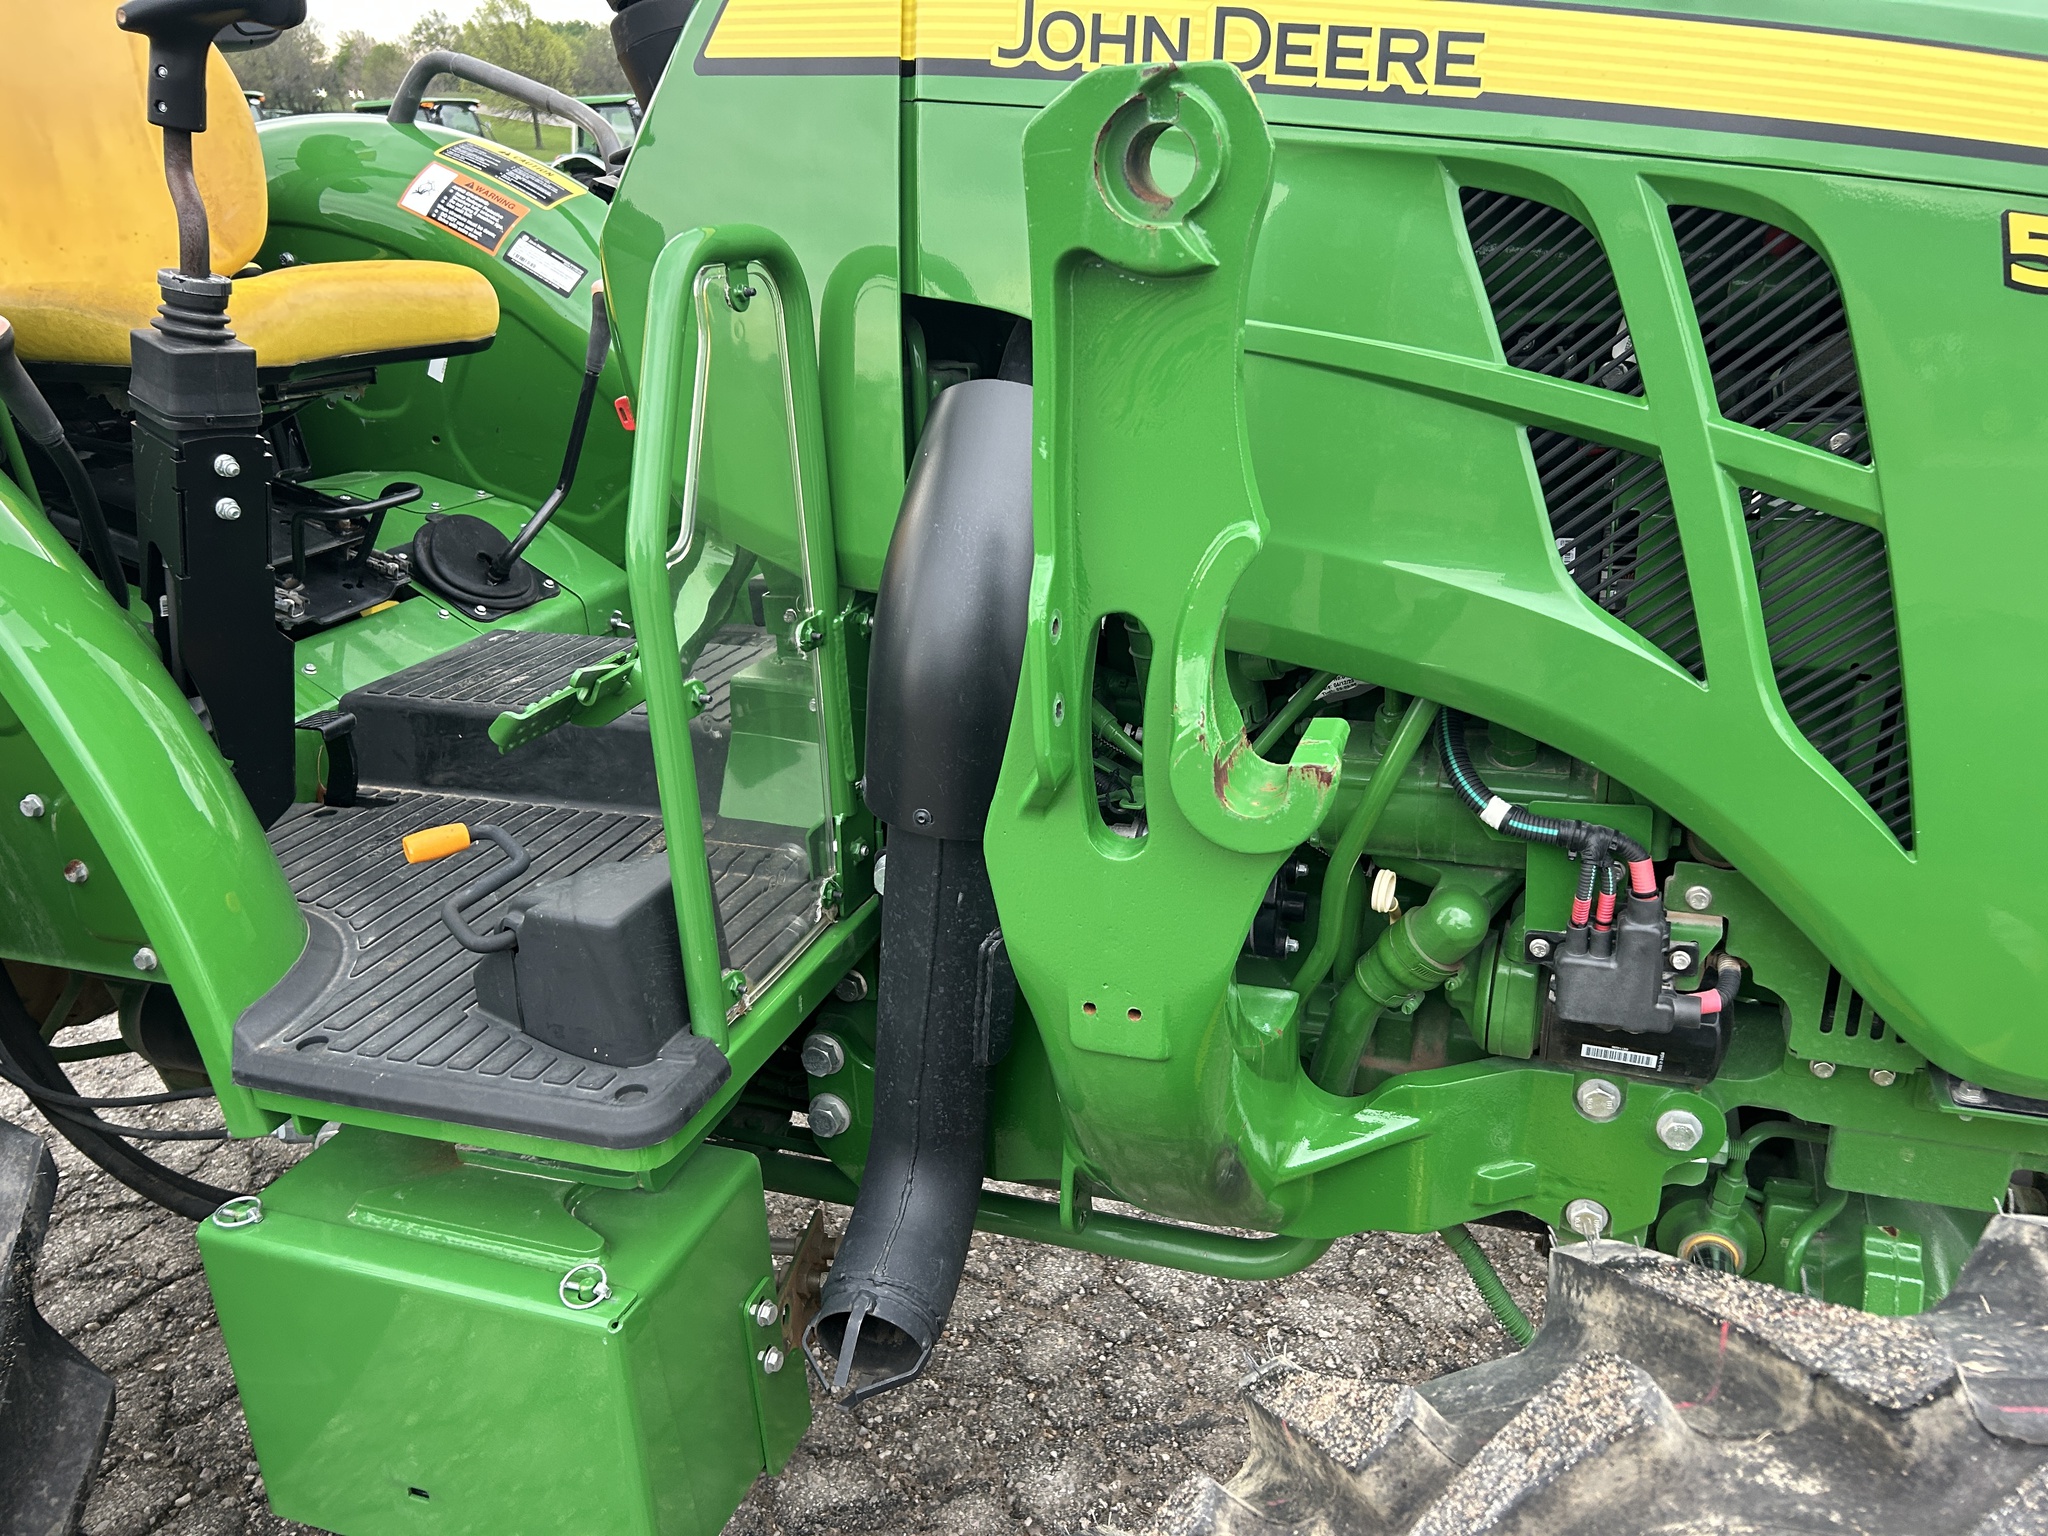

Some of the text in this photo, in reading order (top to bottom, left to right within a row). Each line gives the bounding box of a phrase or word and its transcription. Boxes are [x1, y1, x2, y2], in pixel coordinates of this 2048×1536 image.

[997, 0, 1485, 88] JOHN DEERE
[513, 154, 555, 177] CAUTION
[475, 184, 516, 211] WARNING
[2003, 209, 2048, 293] 5
